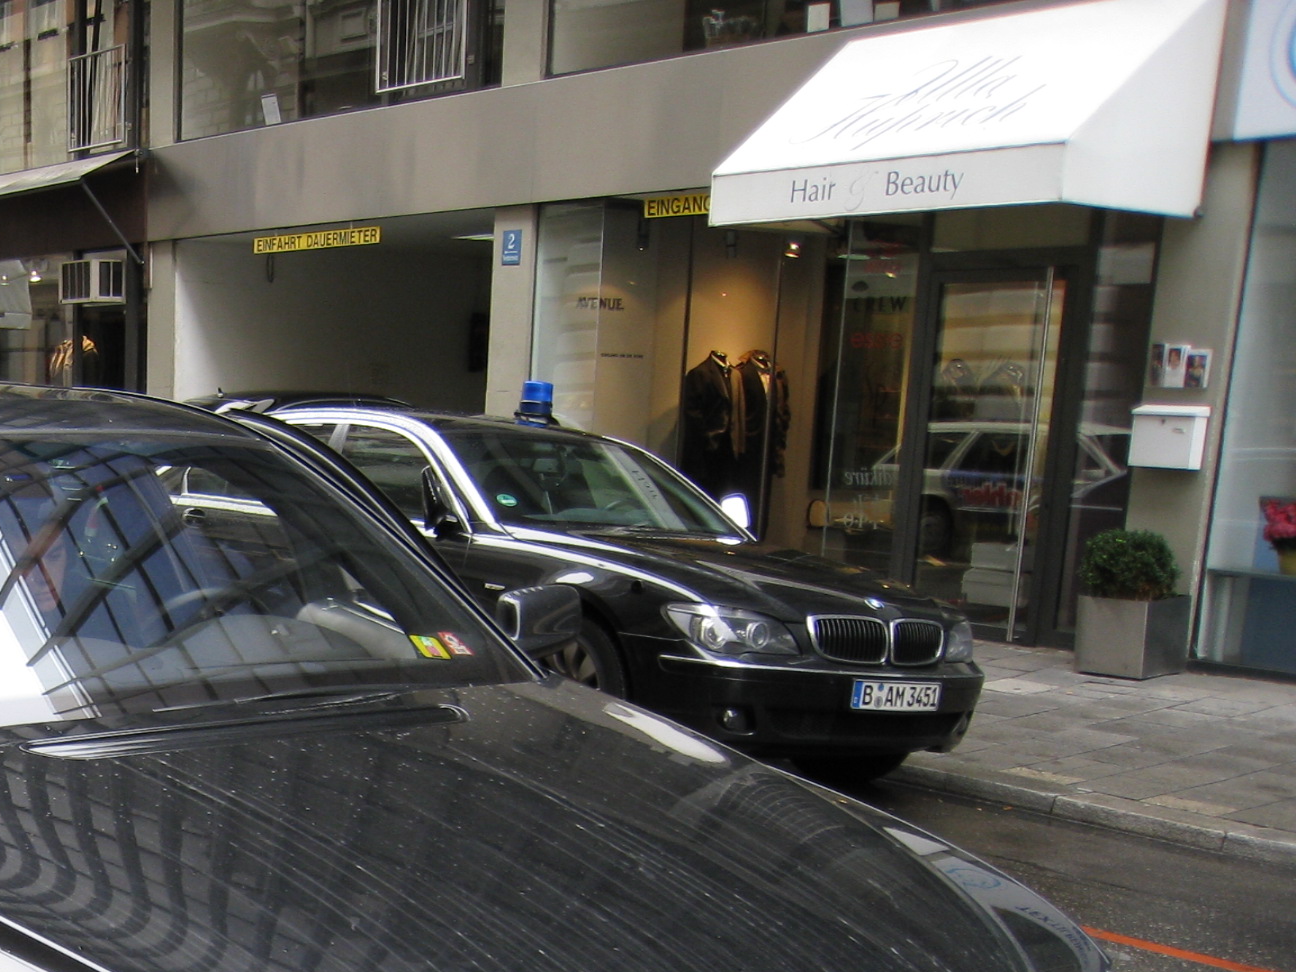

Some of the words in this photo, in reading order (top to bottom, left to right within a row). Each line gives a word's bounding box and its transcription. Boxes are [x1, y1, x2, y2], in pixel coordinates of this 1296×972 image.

[790, 177, 836, 203] Hair
[885, 169, 965, 200] Beauty
[257, 236, 303, 252] EINFAHRT
[306, 228, 378, 248] DAUERMIETER
[507, 233, 515, 249] 2
[862, 684, 873, 706] B
[884, 685, 906, 707] AM
[907, 686, 938, 707] 3451
